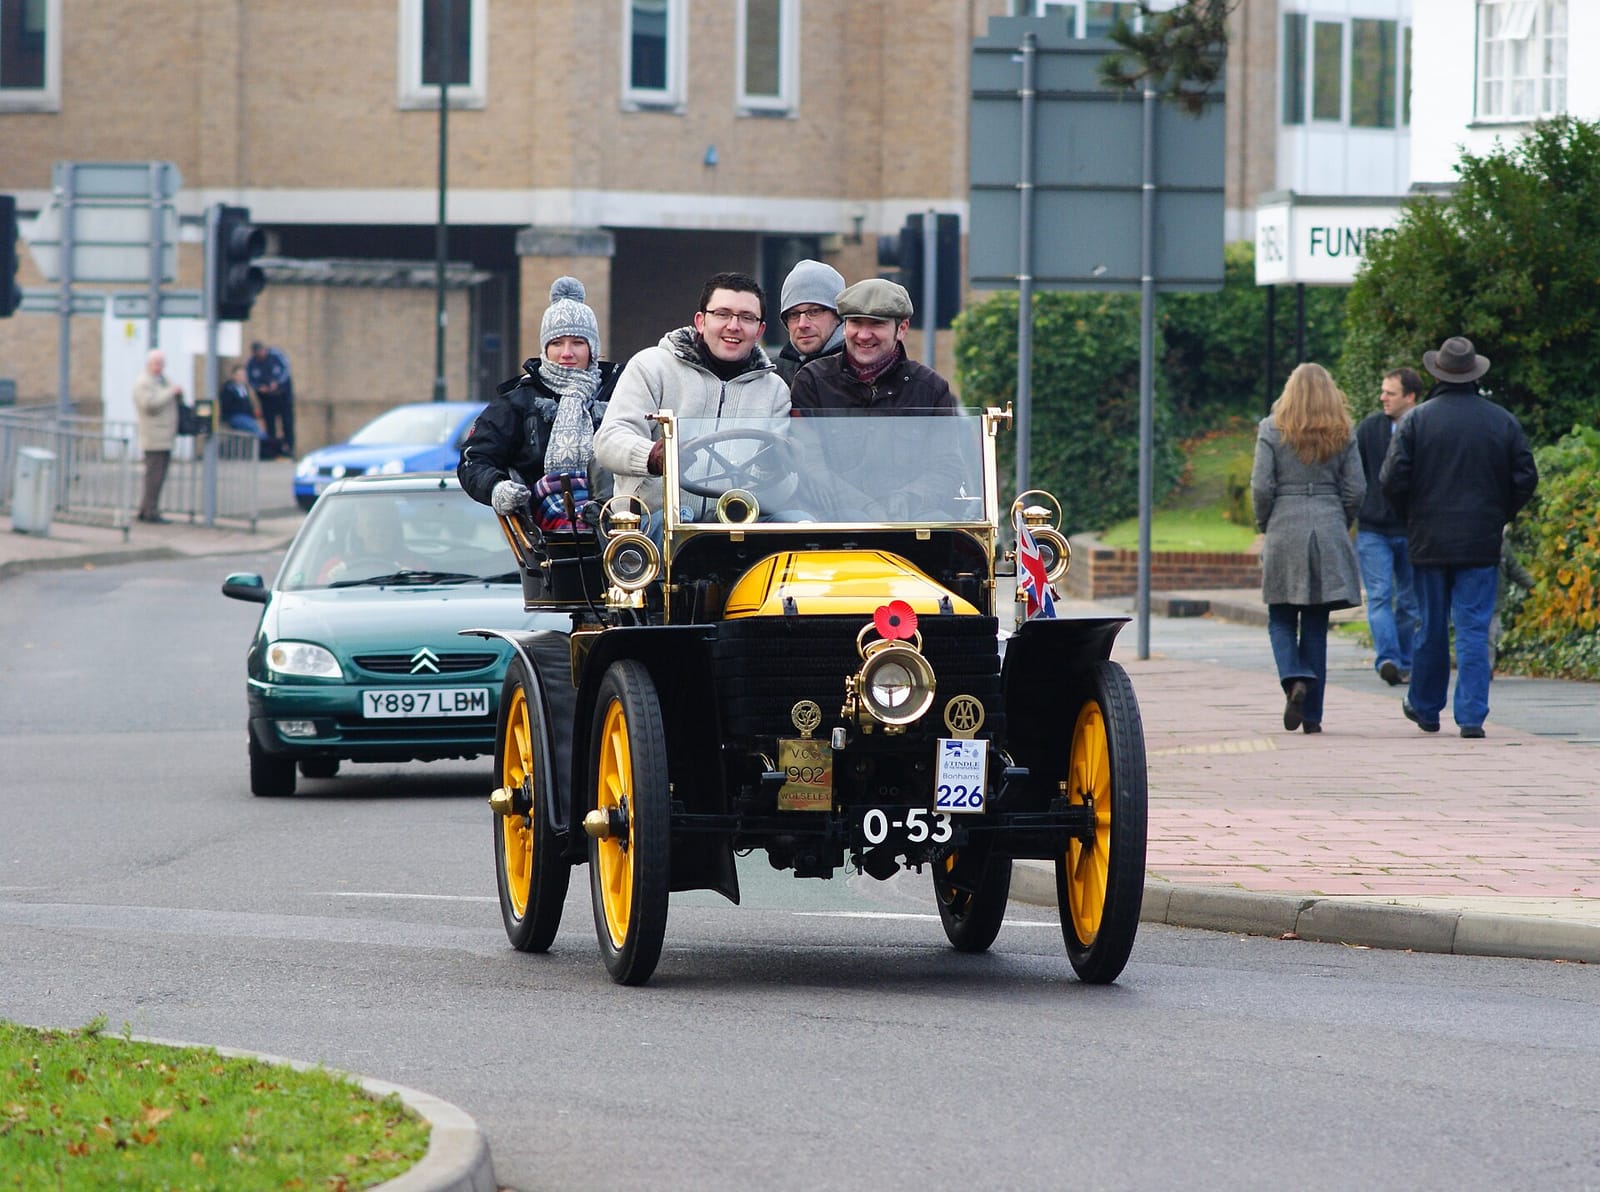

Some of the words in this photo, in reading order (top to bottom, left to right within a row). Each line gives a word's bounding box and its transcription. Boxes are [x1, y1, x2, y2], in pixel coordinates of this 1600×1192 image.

[369, 693, 431, 713] Y897
[439, 691, 485, 712] LBM
[784, 766, 824, 783] 1902
[936, 785, 983, 807] 226
